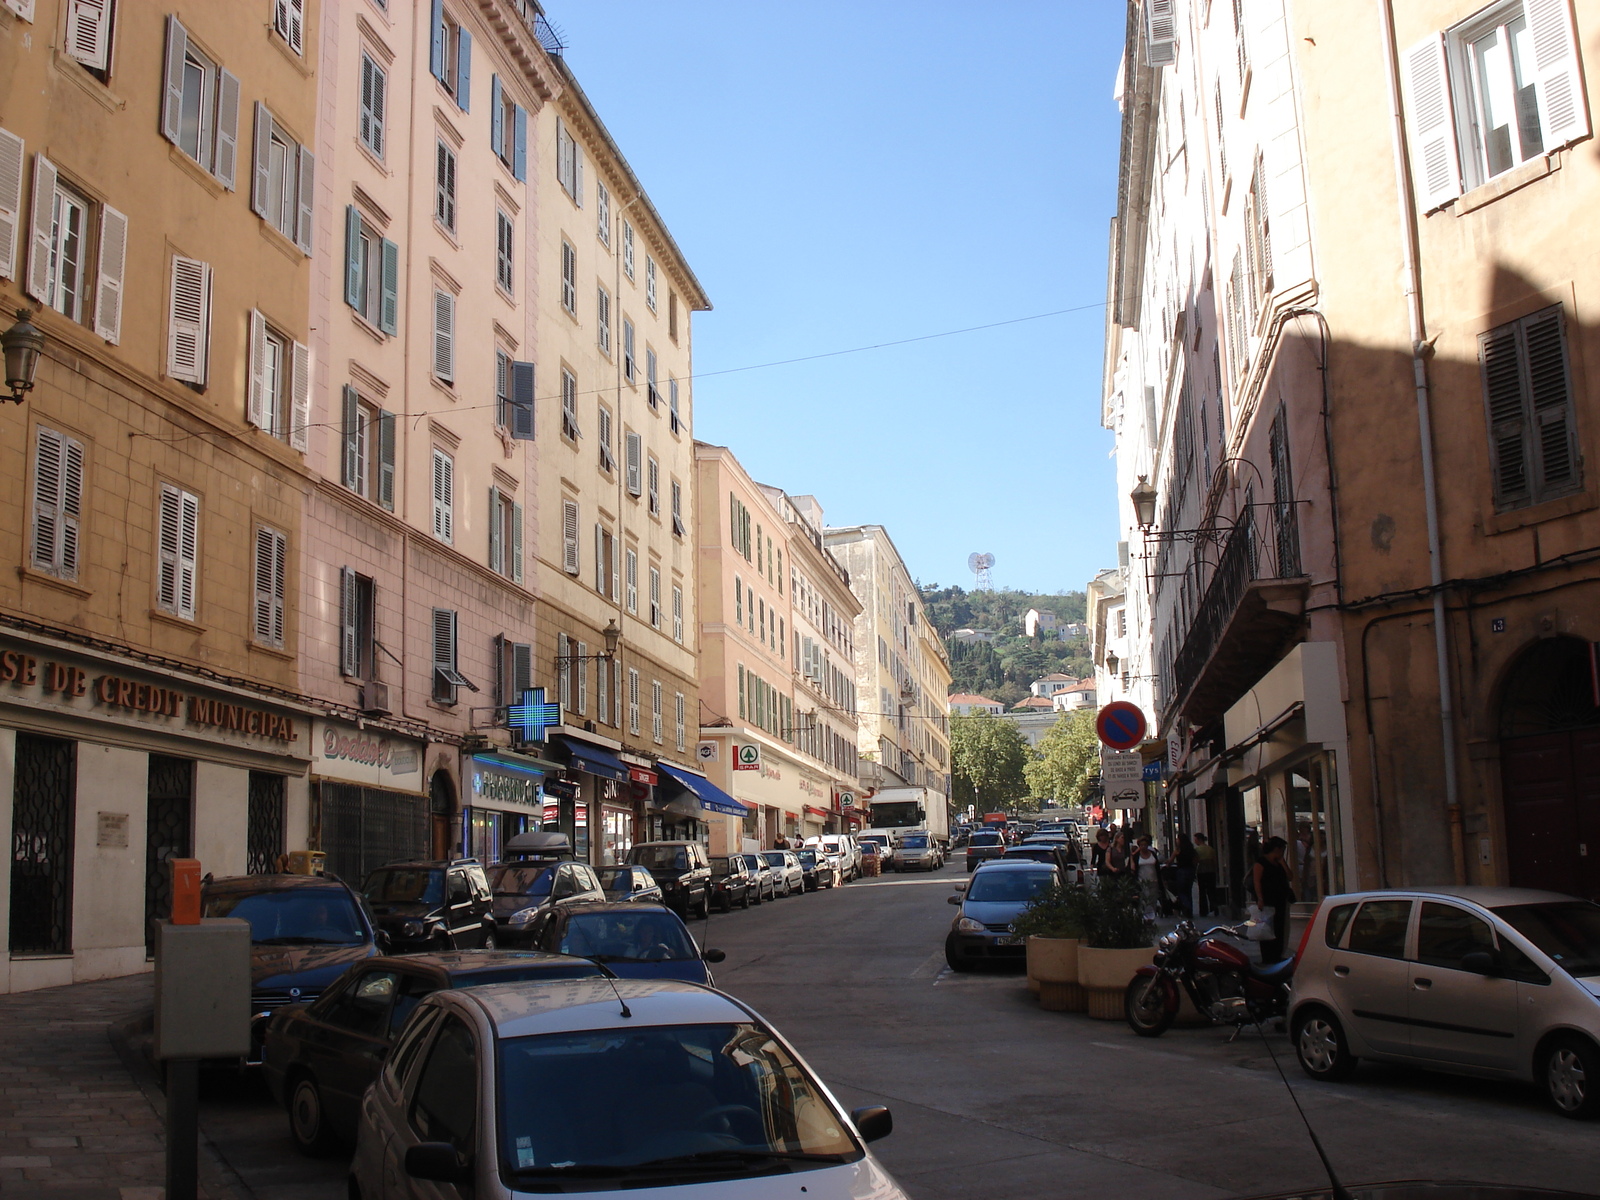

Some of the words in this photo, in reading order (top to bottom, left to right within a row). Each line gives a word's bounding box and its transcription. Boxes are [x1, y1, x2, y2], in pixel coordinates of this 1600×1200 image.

[1493, 620, 1503, 631] 13
[48, 662, 86, 697] DE
[97, 675, 183, 717] CREDIT
[192, 696, 298, 742] MUNICIPAL
[483, 771, 541, 805] PHARMACIE
